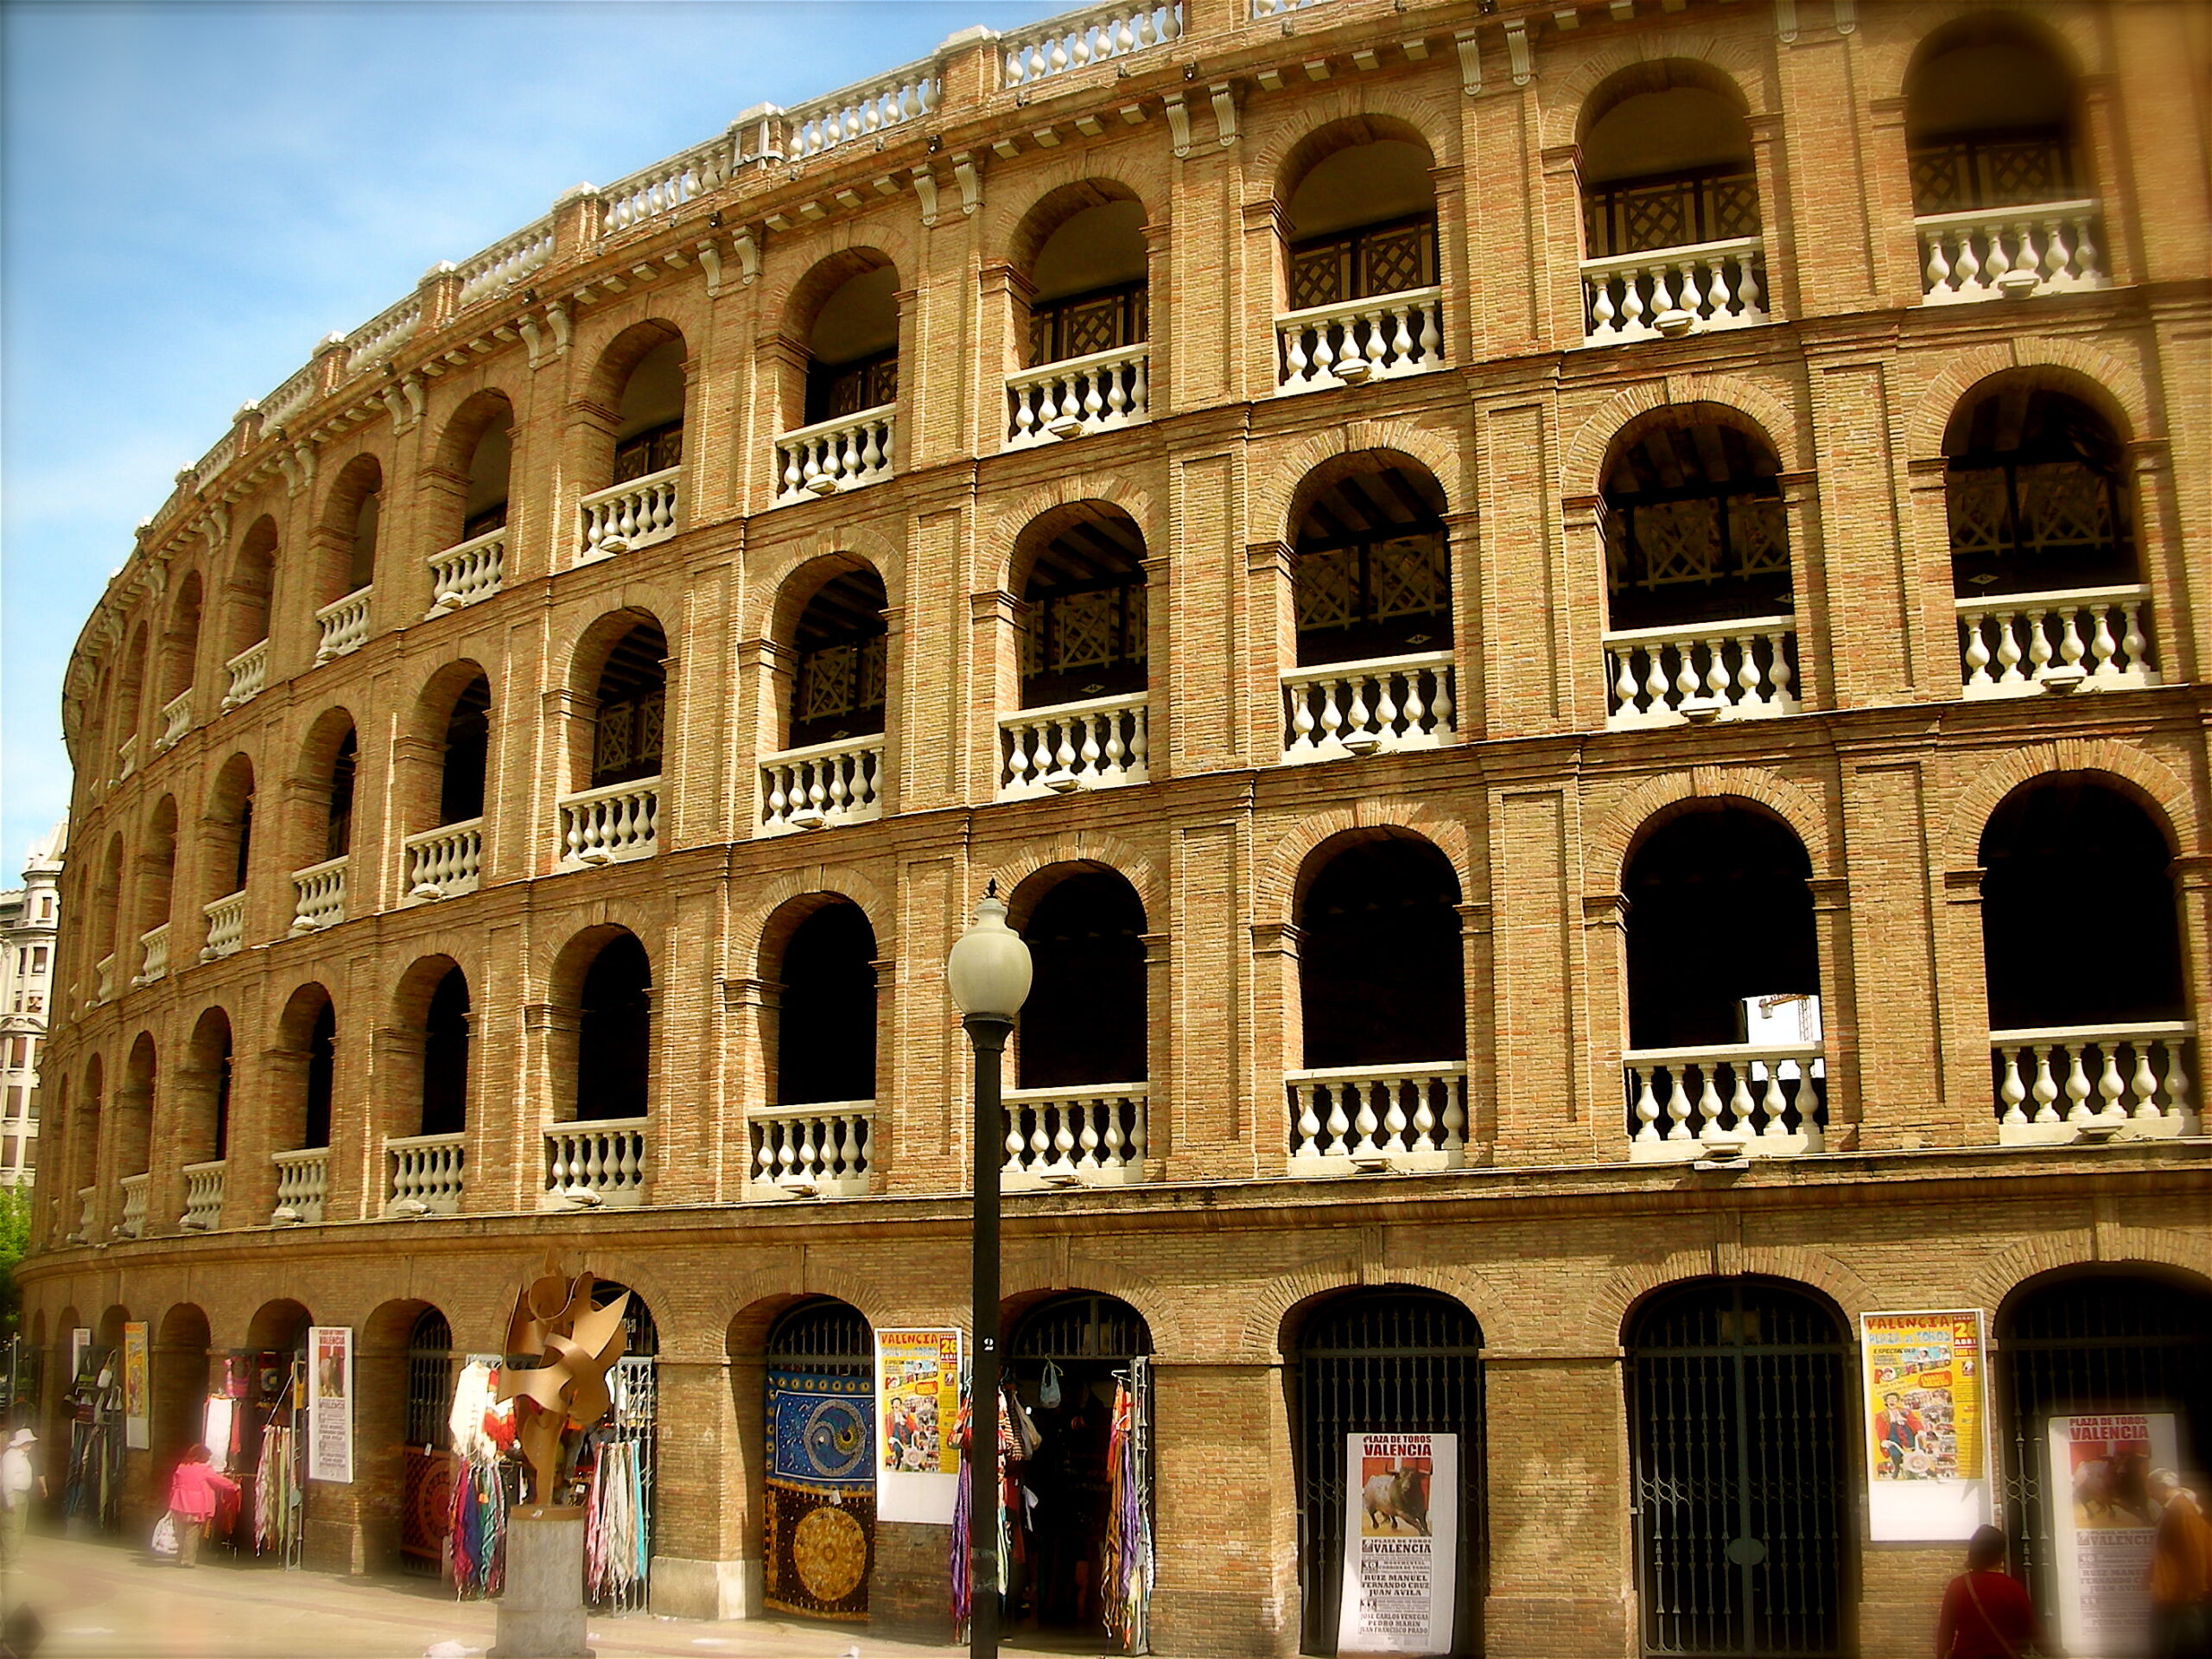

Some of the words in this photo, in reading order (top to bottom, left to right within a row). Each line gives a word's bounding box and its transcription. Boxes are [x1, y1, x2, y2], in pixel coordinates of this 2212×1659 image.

[1866, 1316, 1950, 1330] VALENCIA
[881, 1333, 938, 1344] VALENCIA
[1916, 1331, 1950, 1343] TOROS
[941, 1339, 957, 1353] 26
[984, 1338, 993, 1351] 2
[2069, 1417, 2099, 1426] PLAZA
[2114, 1416, 2148, 1425] TOROS
[2069, 1425, 2150, 1440] VALENCIA
[1363, 1444, 1432, 1456] VALENCIA
[1374, 1544, 1431, 1554] VALENCIA
